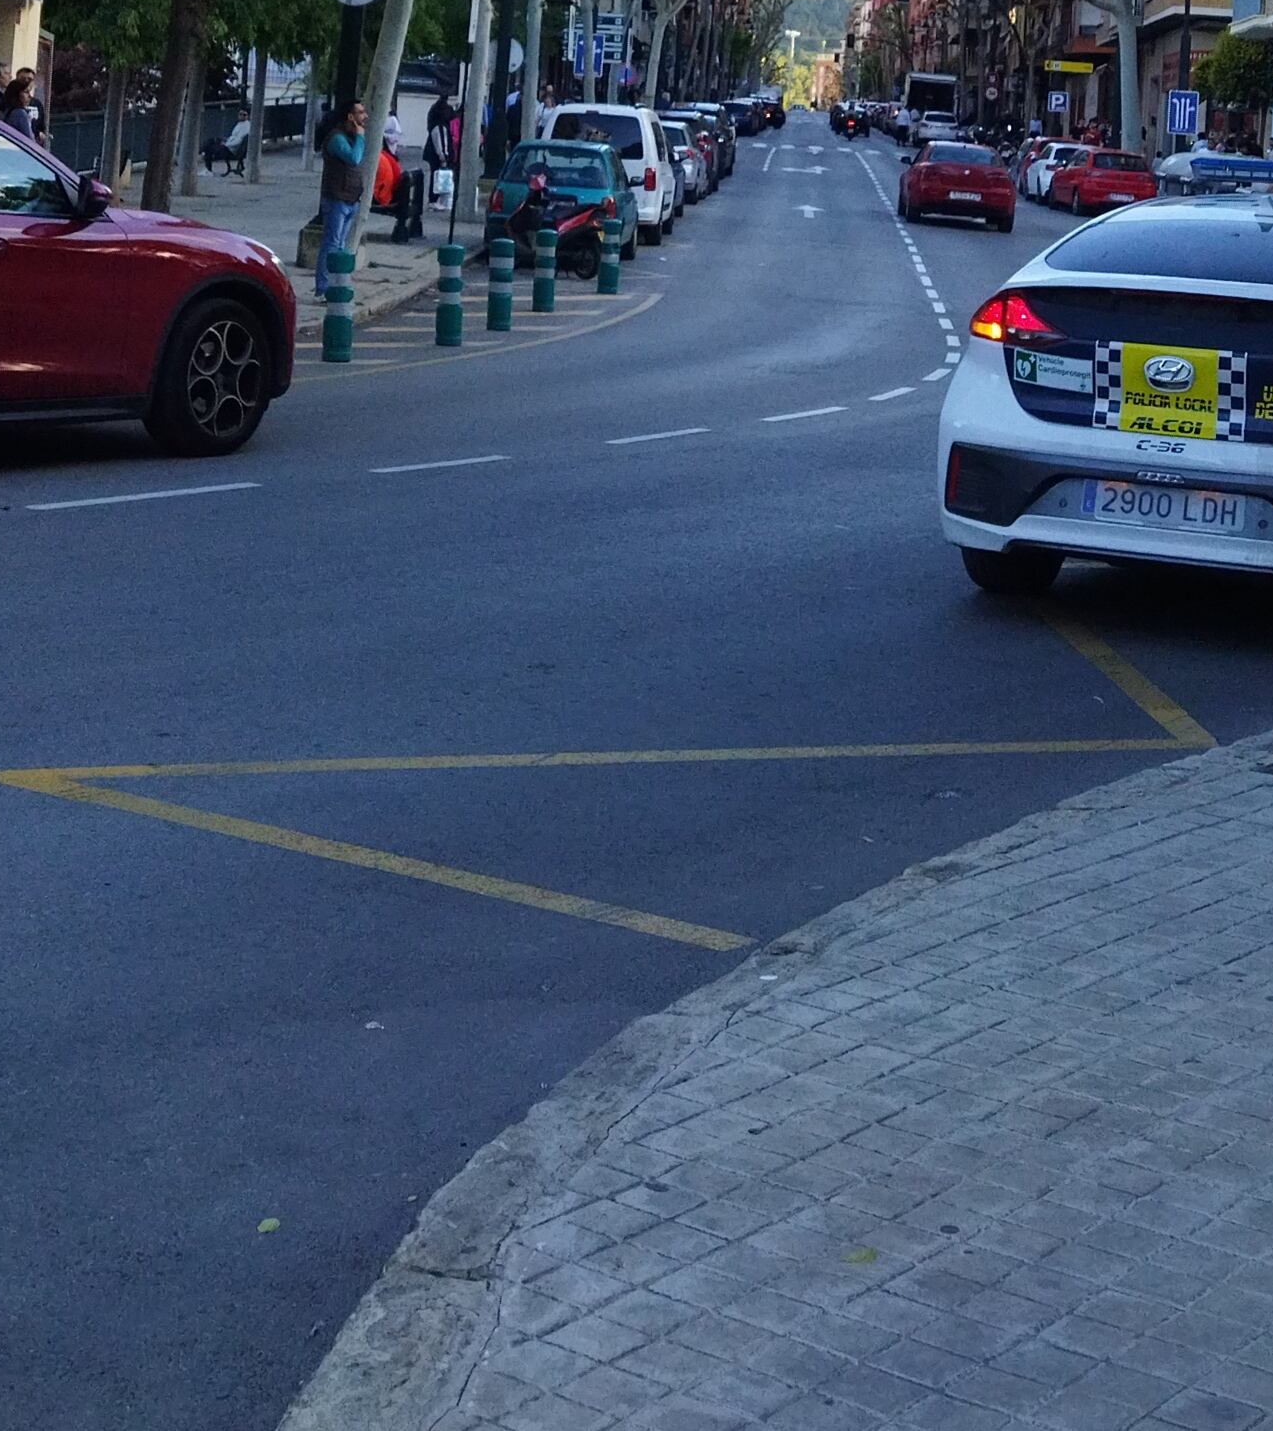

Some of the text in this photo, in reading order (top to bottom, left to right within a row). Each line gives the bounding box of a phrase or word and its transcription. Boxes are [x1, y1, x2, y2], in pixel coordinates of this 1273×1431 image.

[1124, 391, 1215, 414] POLICIA LOCAL
[1129, 416, 1204, 436] ALCOI
[1136, 439, 1187, 454] C-36
[1101, 487, 1239, 526] 2900 LDH
